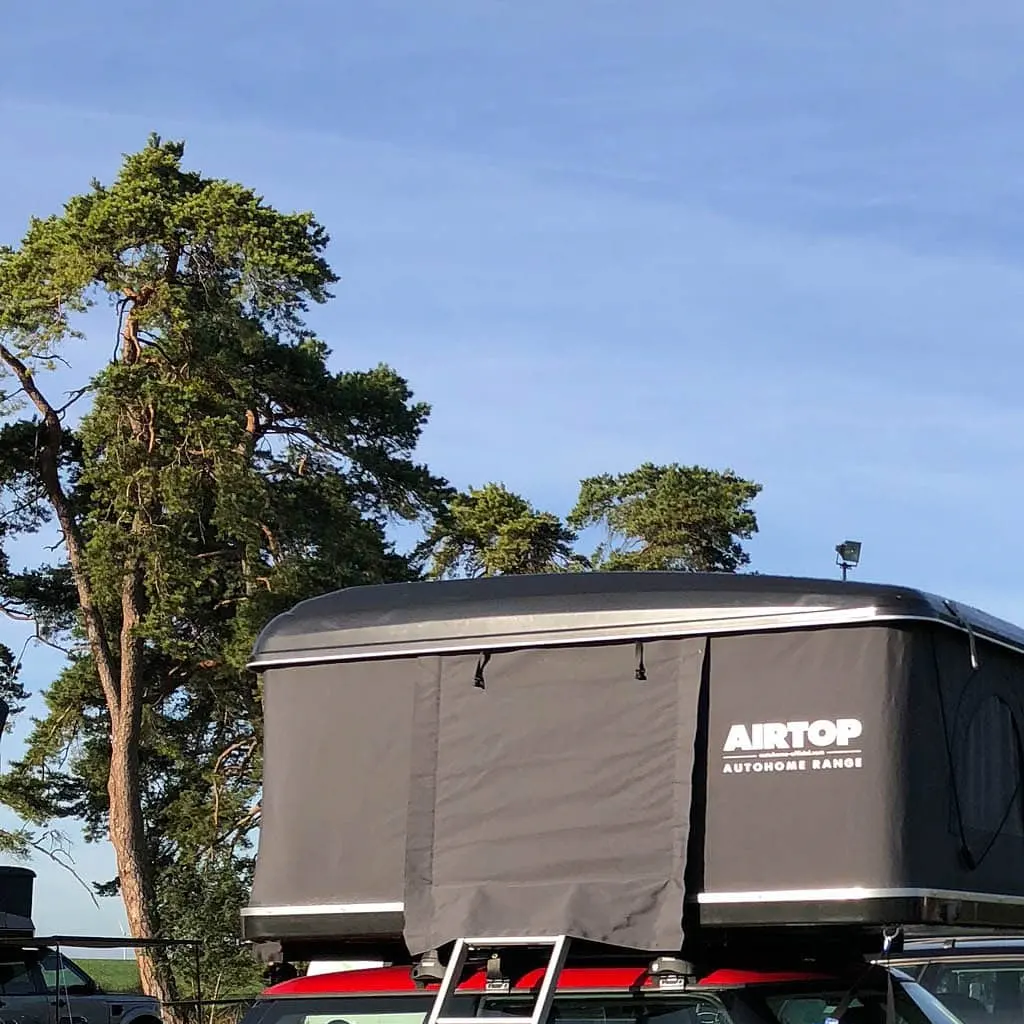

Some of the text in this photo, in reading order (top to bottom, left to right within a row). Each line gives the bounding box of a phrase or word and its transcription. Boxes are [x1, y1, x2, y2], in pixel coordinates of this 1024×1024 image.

[723, 718, 863, 752] AIRTOP
[723, 757, 863, 774] AUTOHOME RANGE
